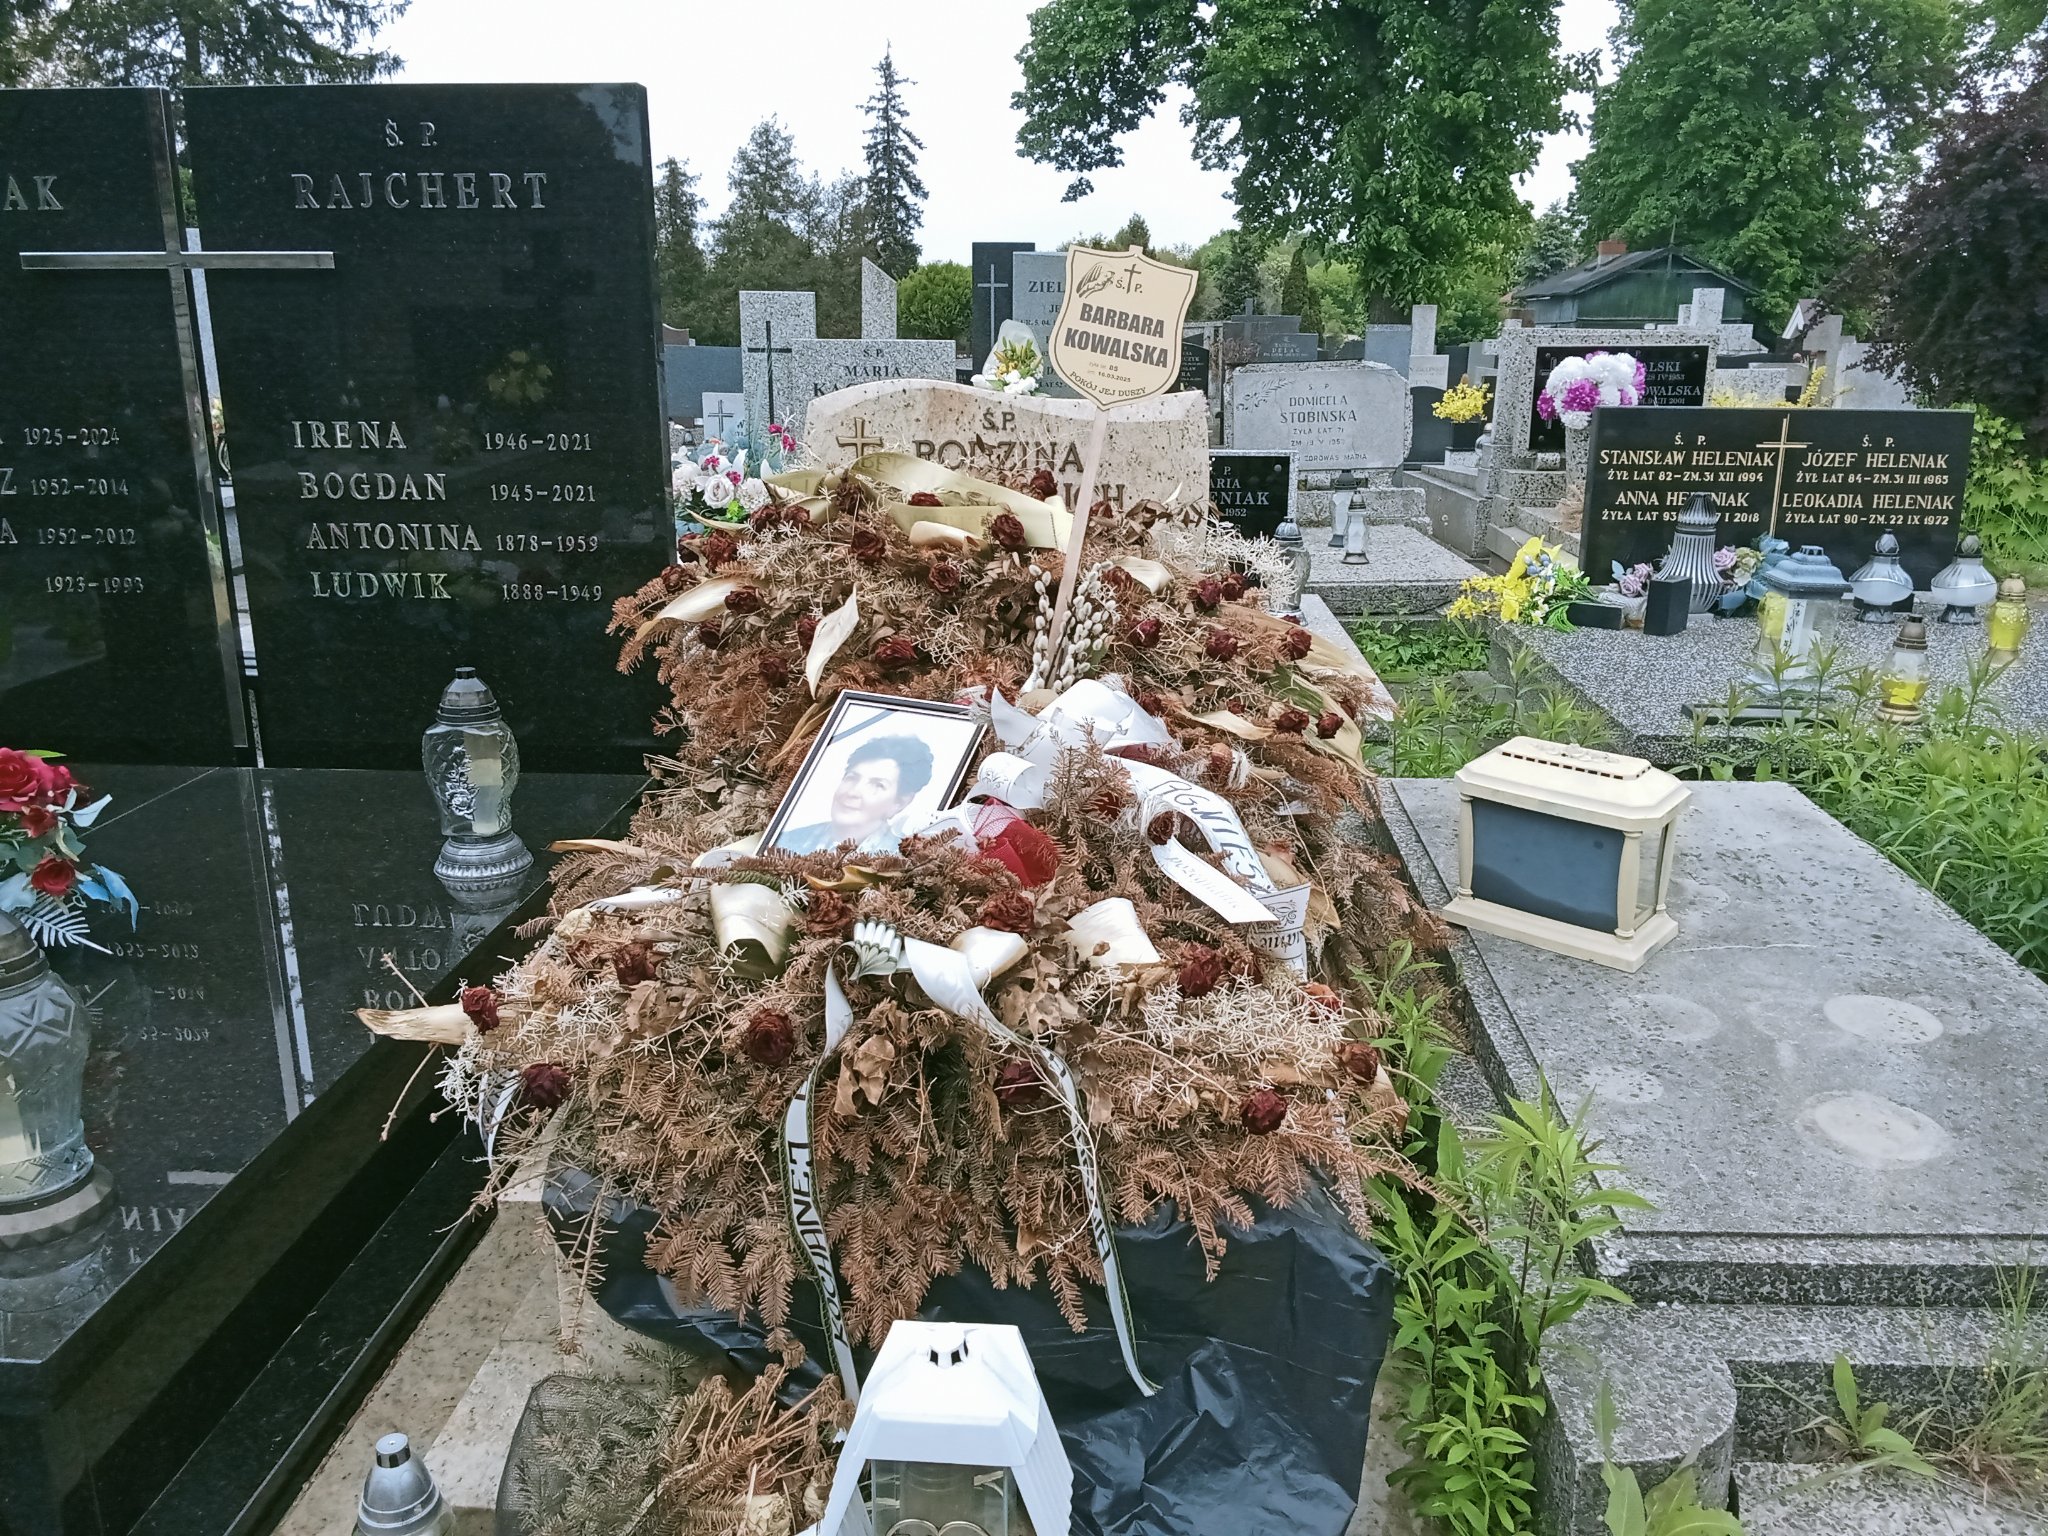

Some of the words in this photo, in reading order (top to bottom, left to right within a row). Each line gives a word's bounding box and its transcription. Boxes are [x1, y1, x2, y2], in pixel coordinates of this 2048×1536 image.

[291, 172, 547, 209] RAJCHERT
[1079, 302, 1165, 338] BARBARA
[1064, 327, 1169, 369] KOWALSKA
[845, 365, 903, 377] MARIA
[1070, 371, 1098, 391] POKÓJ
[1099, 388, 1116, 396] JEJ
[1118, 387, 1146, 397] DUSZY
[1289, 395, 1348, 407] DOMICELA
[292, 421, 407, 449] IRENA
[485, 432, 592, 450] 1946-2021
[913, 439, 1085, 473] RODZINA
[1600, 450, 1686, 466] STANISŁAW
[1692, 451, 1776, 467] HELENIAK
[1802, 449, 1858, 467] JÓZEF
[1865, 453, 1949, 469] HELENIAK
[297, 471, 446, 500] BOGDAN
[490, 484, 596, 502] 1945-2021
[1607, 468, 1629, 480] ŻYŁ
[1633, 471, 1655, 480] LAT
[1718, 472, 1734, 482] XII
[1738, 472, 1763, 482] 1994
[1796, 471, 1818, 483] ŻYŁ
[1822, 473, 1844, 483] LAT
[1907, 475, 1920, 484] III
[1923, 474, 1949, 485] 1965
[1615, 491, 1659, 506] ANNA
[1666, 491, 1750, 507] HENIAK
[1782, 493, 1863, 508] LEOKADIA
[1872, 494, 1956, 510] HELENIAK
[1602, 509, 1632, 521] ŻYŁA
[1637, 511, 1659, 521] LAT
[1733, 513, 1760, 523] 2018
[1785, 511, 1815, 524] ŻYŁA
[1819, 514, 1840, 524] LAT
[1907, 515, 1920, 525] IX
[1923, 515, 1949, 525] 1972
[306, 522, 482, 550] ANTONINA
[496, 534, 599, 552] 1878-1959
[310, 571, 452, 599] LUDWIK
[502, 584, 602, 601] 1888-1949
[788, 1141, 849, 1348] KOCHANEJ
